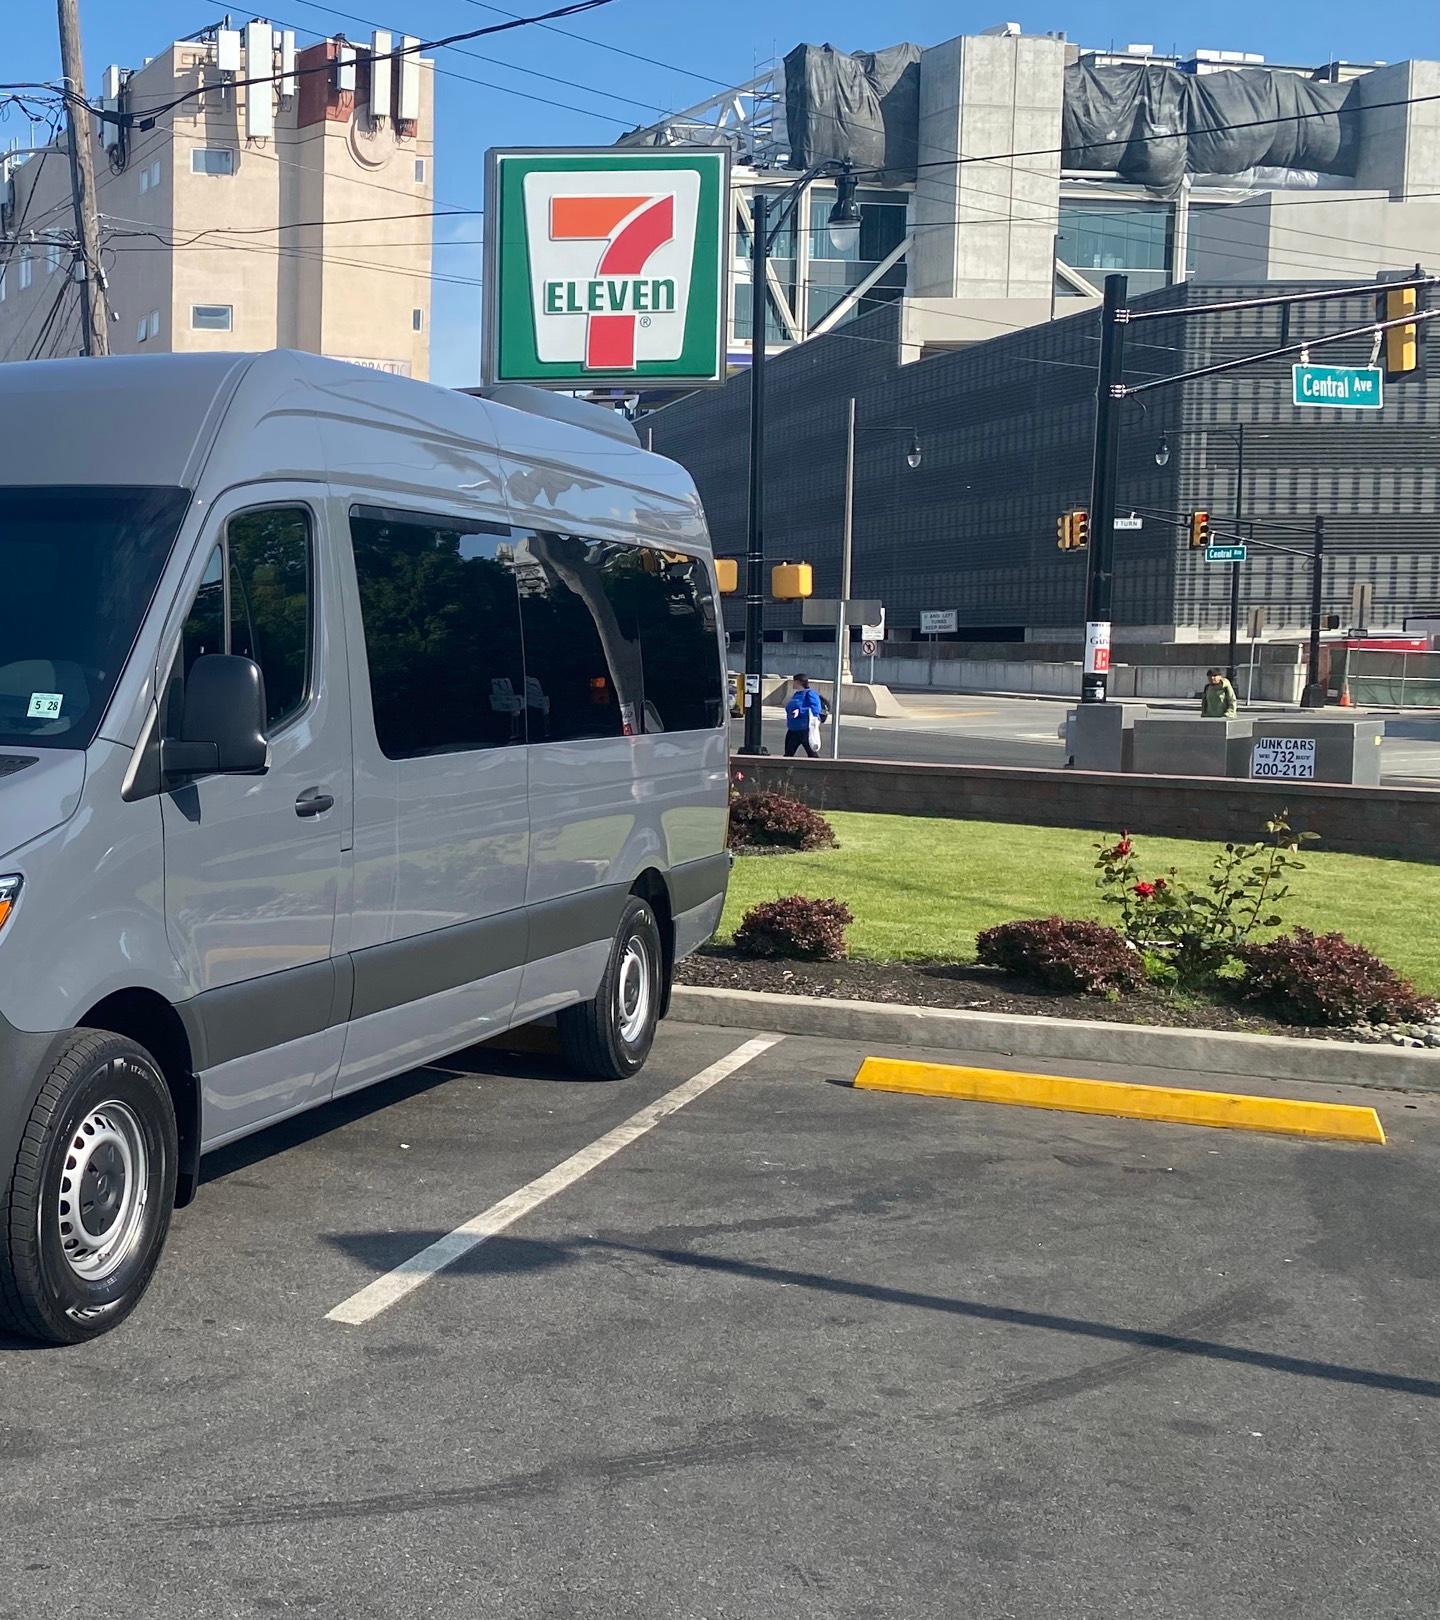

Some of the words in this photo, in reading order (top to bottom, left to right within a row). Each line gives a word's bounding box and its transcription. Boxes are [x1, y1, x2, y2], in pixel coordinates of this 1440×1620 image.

[552, 194, 675, 367] 7
[1303, 373, 1350, 398] Central
[1353, 376, 1373, 392] Ave
[1209, 549, 1233, 559] Central
[35, 700, 42, 710] 5
[47, 701, 59, 711] 28
[1256, 739, 1283, 750] JUNK
[1285, 740, 1314, 751] CARS
[1272, 750, 1295, 763] 732
[1255, 763, 1312, 776] 200-2121
